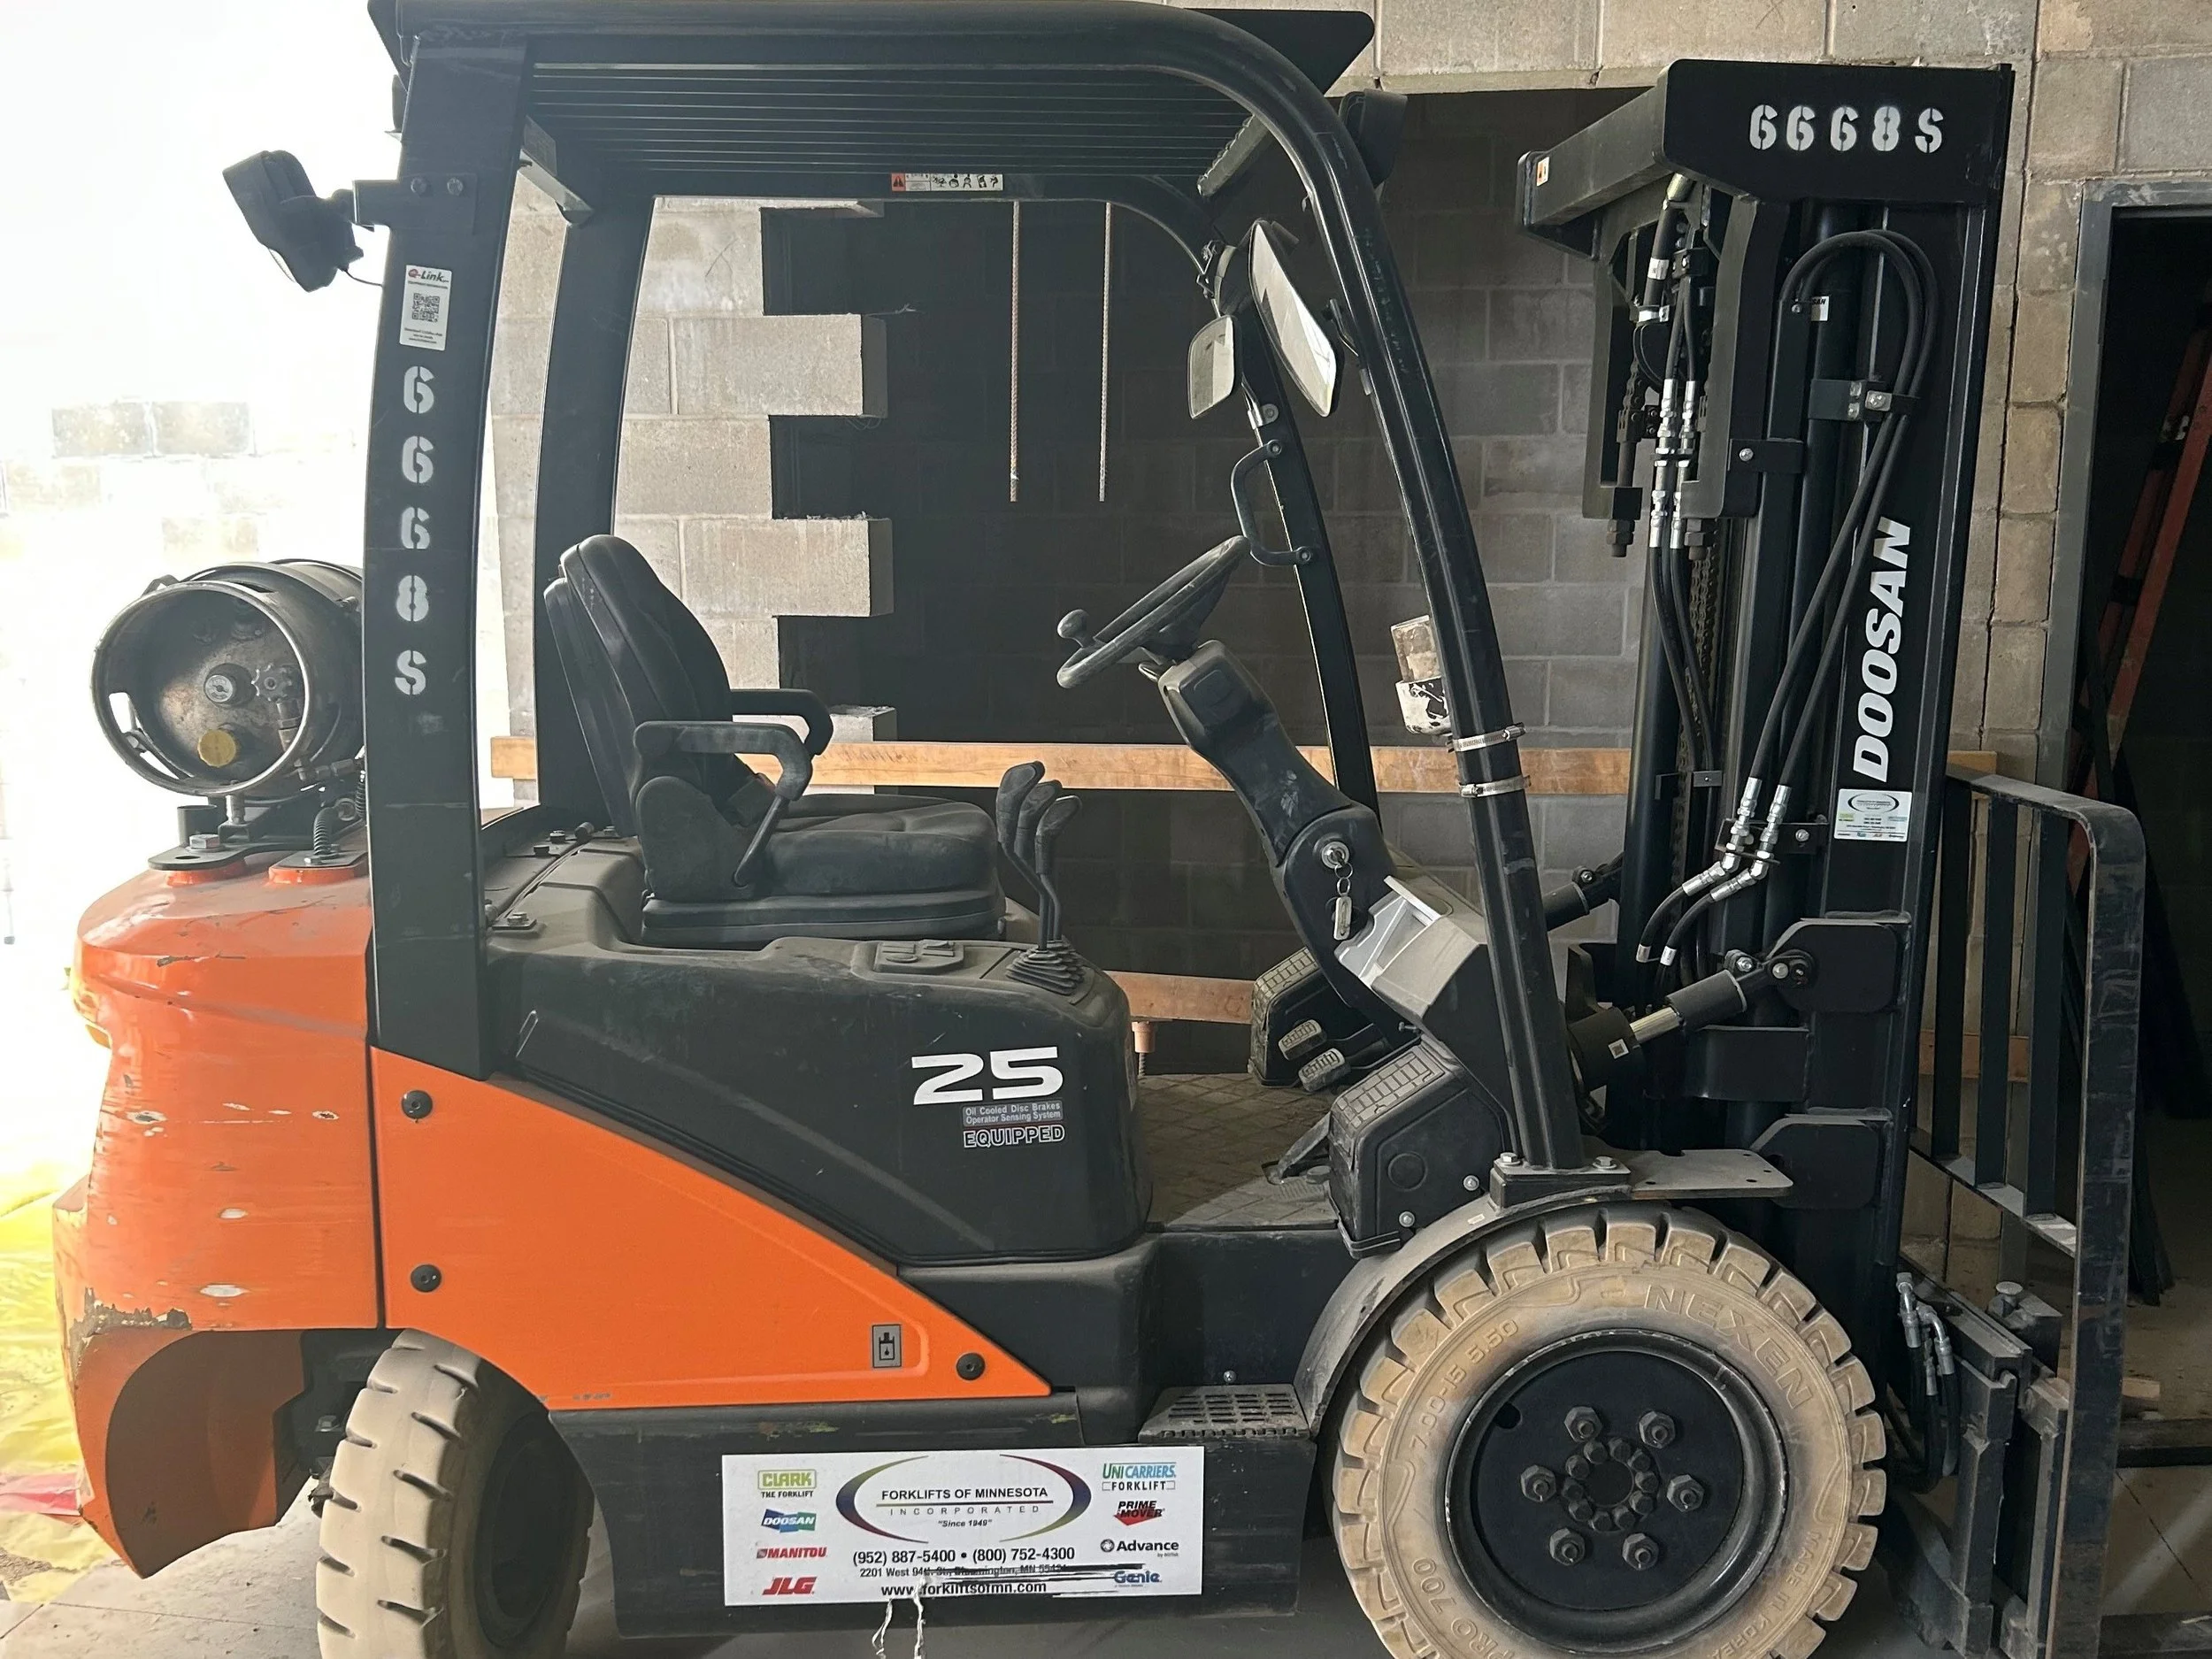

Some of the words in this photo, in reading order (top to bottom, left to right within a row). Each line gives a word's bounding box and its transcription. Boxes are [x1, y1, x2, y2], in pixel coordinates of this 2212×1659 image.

[1748, 104, 1944, 154] 6668S
[1853, 516, 1911, 783] DOOSAN
[911, 1046, 1064, 1106] 25
[965, 1107, 977, 1117] Oil
[979, 1106, 1008, 1116] Cooled
[1010, 1104, 1029, 1113] Disc
[1032, 1102, 1061, 1111] Brakes
[965, 1115, 999, 1125] Operator
[1000, 1112, 1032, 1123] Sensing
[1033, 1110, 1061, 1121] System
[963, 1124, 1065, 1148] EQUIPPED
[1466, 1318, 1519, 1364] 5.50
[1644, 1284, 1813, 1409] NEXEN
[761, 1471, 812, 1488] CLARK
[1111, 1480, 1166, 1491] FORKLIFT
[761, 1490, 775, 1499] THE
[881, 1489, 951, 1501] FORKLIFTS
[954, 1488, 972, 1499] OF
[975, 1487, 1048, 1498] MINNESOTA
[890, 1505, 1040, 1516] INCORPORATED
[1118, 1500, 1157, 1509] PRIME
[763, 1516, 816, 1526] DOOSAN
[767, 1547, 827, 1559] MANITOU
[1116, 1540, 1179, 1552] Advance
[853, 1550, 887, 1566] (952)
[891, 1548, 956, 1563] 887-5400
[972, 1548, 1007, 1564] (800)
[1010, 1547, 1075, 1561] 752-4300
[860, 1567, 882, 1578] 2201
[886, 1566, 910, 1577] West
[1114, 1571, 1161, 1584] Genie
[762, 1576, 818, 1595] JLG
[880, 1581, 1047, 1596] wwwforkliftsofmn.com
[1412, 1557, 1457, 1616] 700
